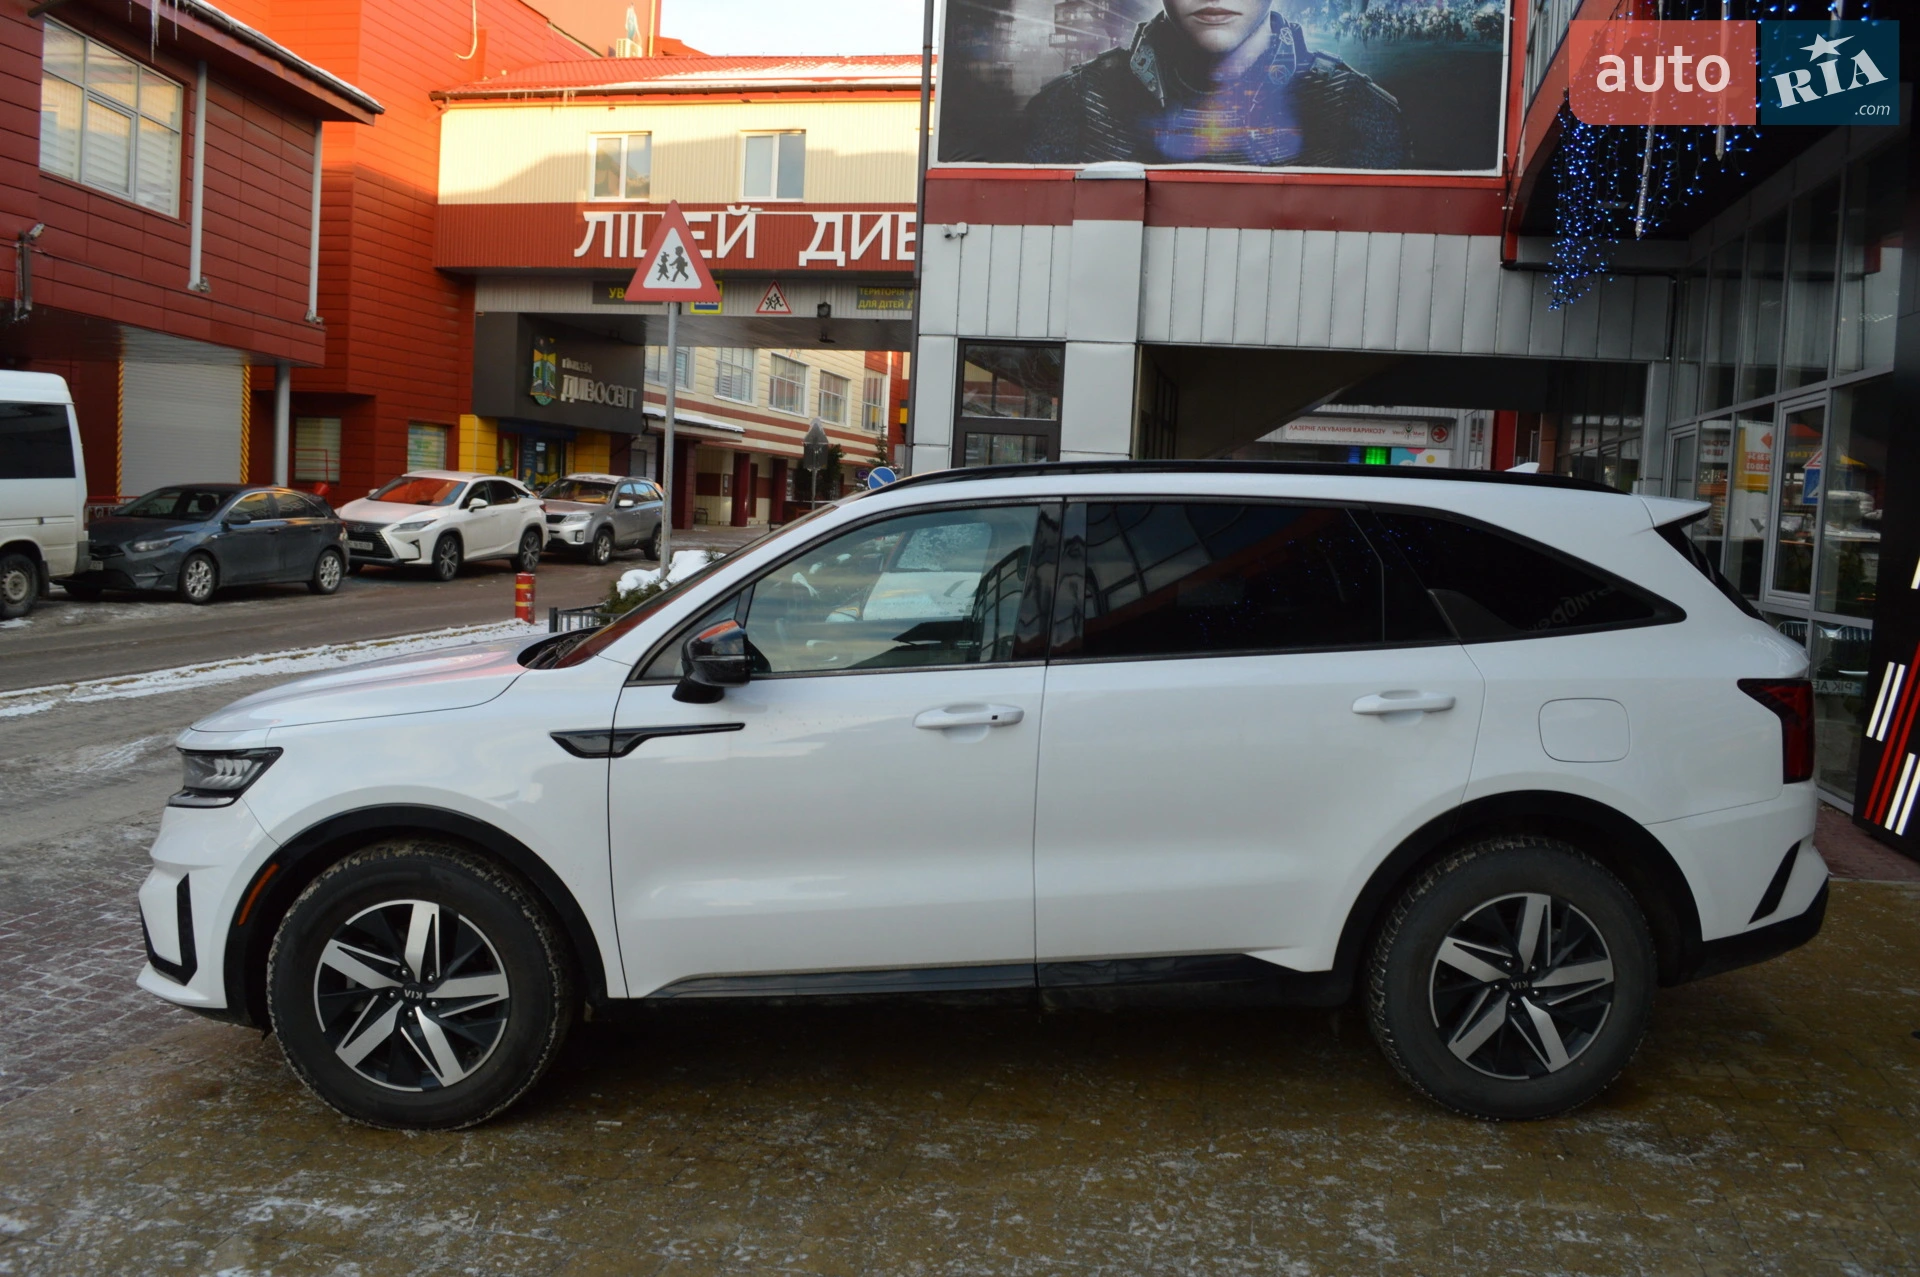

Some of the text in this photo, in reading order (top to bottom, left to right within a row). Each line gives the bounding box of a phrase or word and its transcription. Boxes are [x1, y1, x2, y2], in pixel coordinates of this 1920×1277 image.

[859, 287, 906, 296] ТЕРИТОРІЯ
[858, 298, 904, 309] ДЛЯ ДІТЕЙ
[560, 374, 638, 409] ДИВОСВІТ
[1289, 424, 1317, 432] ЛАЗЕРНЕ
[1352, 427, 1387, 435] ВАРИКОЗУ
